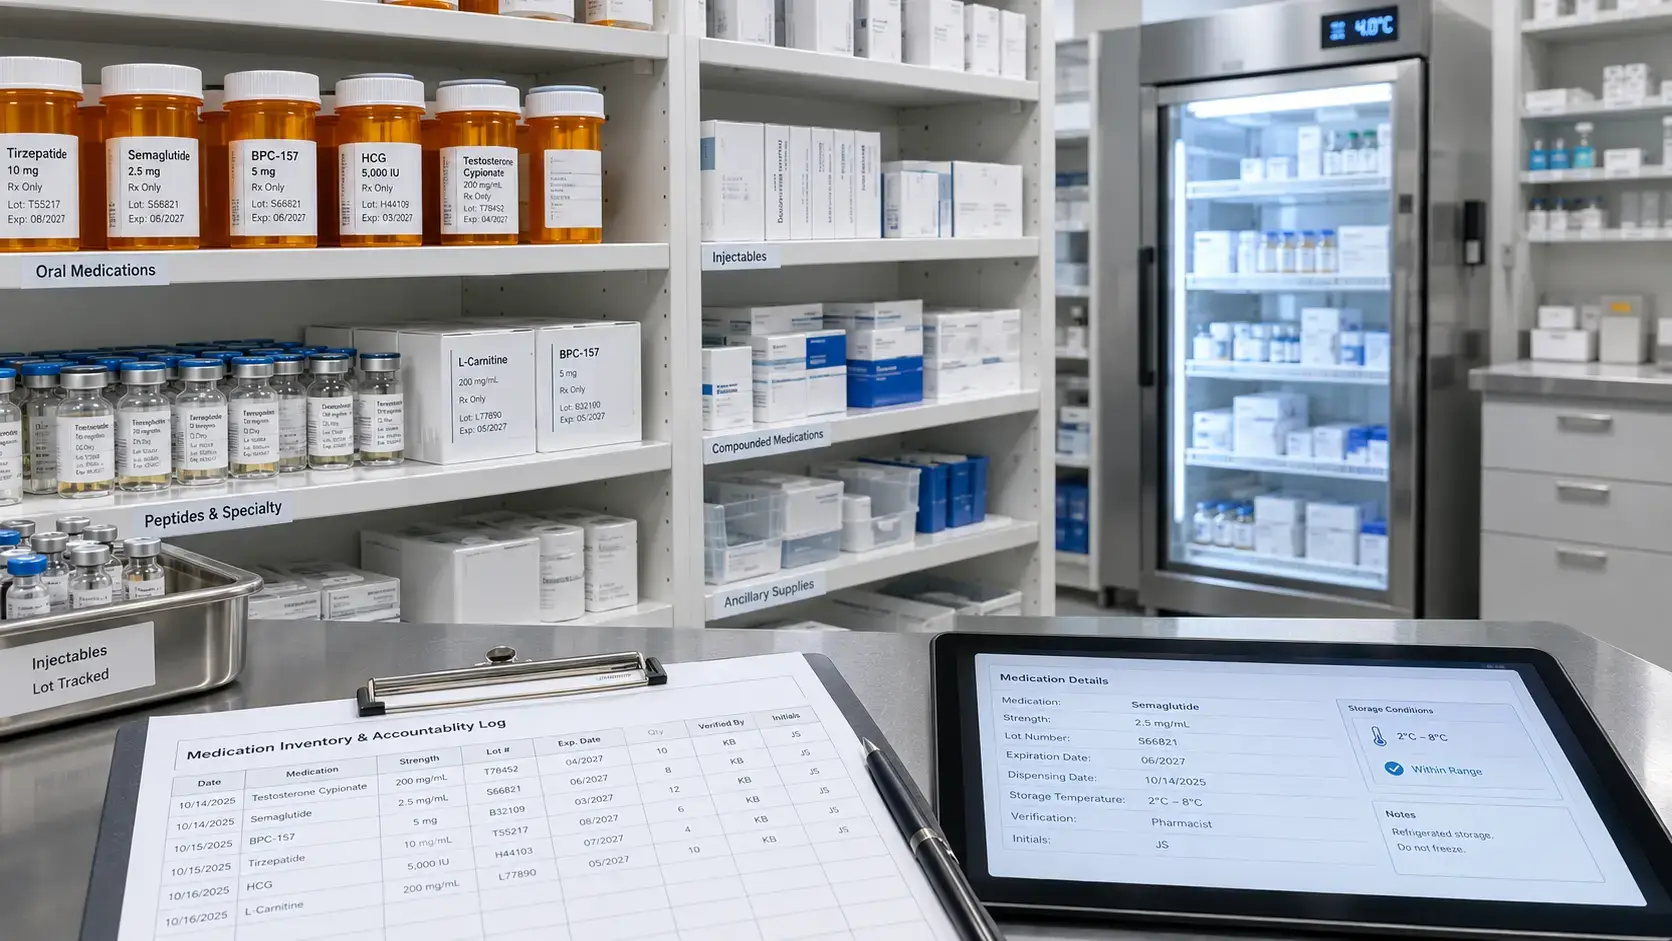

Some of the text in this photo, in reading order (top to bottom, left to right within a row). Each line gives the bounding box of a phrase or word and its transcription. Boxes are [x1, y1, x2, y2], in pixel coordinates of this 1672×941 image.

[7, 148, 67, 160] Tirzepatide
[128, 150, 190, 162] Semaglutide
[252, 151, 298, 160] BPC-157
[362, 153, 386, 162] HCG
[463, 156, 513, 166] Testosterone
[8, 166, 38, 177] 10 mg
[128, 167, 160, 178] 2.5 mg
[260, 168, 275, 178] mg
[362, 168, 400, 178] 5,000 IU
[463, 168, 504, 178] Cypionate
[8, 182, 42, 193] Rx Only
[128, 183, 161, 193] Rx Only
[252, 183, 285, 193] Rx Only
[362, 184, 393, 194] Rx Only
[8, 200, 60, 209] Lot: T55217
[129, 200, 178, 208] Lot: S66821
[252, 200, 268, 208] Lot:
[8, 214, 65, 225] Exp: 08/2027
[129, 214, 184, 224] Exp: 06/2027
[252, 214, 306, 224] Exp: 06/2027
[362, 214, 413, 223] Exp: 03/2027
[712, 250, 767, 264] Injectables
[36, 264, 156, 278] Oral Medications
[560, 347, 600, 359] BPC-157
[458, 355, 508, 367] L-Carnitine
[459, 378, 472, 386] 200
[470, 395, 486, 404] Only
[712, 429, 824, 455] Compounded Medications
[145, 500, 282, 529] Peptides & Specialty
[724, 579, 814, 609] Ancillary Supplies
[32, 644, 108, 671] Injectables
[32, 668, 109, 694] Lot Tracked
[1000, 674, 1109, 685] Medication Details
[1002, 697, 1200, 711] Medication: Semaglutide
[1348, 705, 1434, 714] Storage Conditions
[1003, 714, 1051, 724] Strength:
[1154, 721, 1190, 729] mg/mL
[187, 718, 506, 760] Medication Inventory & Accountablity Log
[1025, 733, 1070, 742] Number:
[1138, 737, 1177, 746] S66821
[1397, 732, 1448, 742] 2°C 8°C
[286, 766, 339, 777] Medication
[400, 755, 440, 766] Strength
[580, 737, 601, 745] Date
[698, 720, 732, 730] Verified
[734, 719, 745, 727] By
[772, 712, 800, 721] Initials
[1006, 751, 1185, 766] Expiration Date: 06/2027
[180, 797, 236, 809] 10/14/2025
[252, 789, 315, 801] Testosterone
[318, 783, 367, 796] Cypionate
[396, 778, 413, 786] 200
[416, 774, 448, 784] mg/mL
[484, 766, 519, 775] T78452
[565, 755, 603, 766] 04/2027
[723, 738, 736, 746] KB
[1411, 765, 1483, 777] Within Range
[1008, 771, 1206, 786] Dispensing Date: 10/14/2025
[176, 757, 744, 830] 10/14/2025 Semaglutide 2.5 mg/mL S66821 06/2027 KB
[1009, 791, 1203, 807] Storage Temperature: 2°C 8°C
[175, 840, 233, 853] 10/15/2025
[249, 833, 295, 845] BPC-157
[422, 817, 437, 826] mg
[489, 806, 525, 816] B32109
[575, 794, 613, 806] 03/2027
[738, 776, 752, 784] KB
[1385, 810, 1416, 818] Notes
[1011, 812, 1212, 829] Verification: Pharmacist
[172, 796, 760, 876] 10/15/2025 Tirzepatide 10 mg/mL T55217 08/2027 KB
[1392, 828, 1494, 841] Refrigerated storage.
[1013, 834, 1169, 849] Initials: JS
[1397, 843, 1466, 853] Do not freeze.
[169, 886, 230, 901] 10/16/2025
[247, 881, 272, 891] HCG
[407, 860, 436, 871] 5,000
[439, 858, 450, 866] IU
[584, 834, 623, 847] 07/2027
[754, 815, 768, 824] KB
[166, 836, 777, 927] 10/16/2025 L-Carnitine 200 mg/mL L77890 05/2027 10 KB
